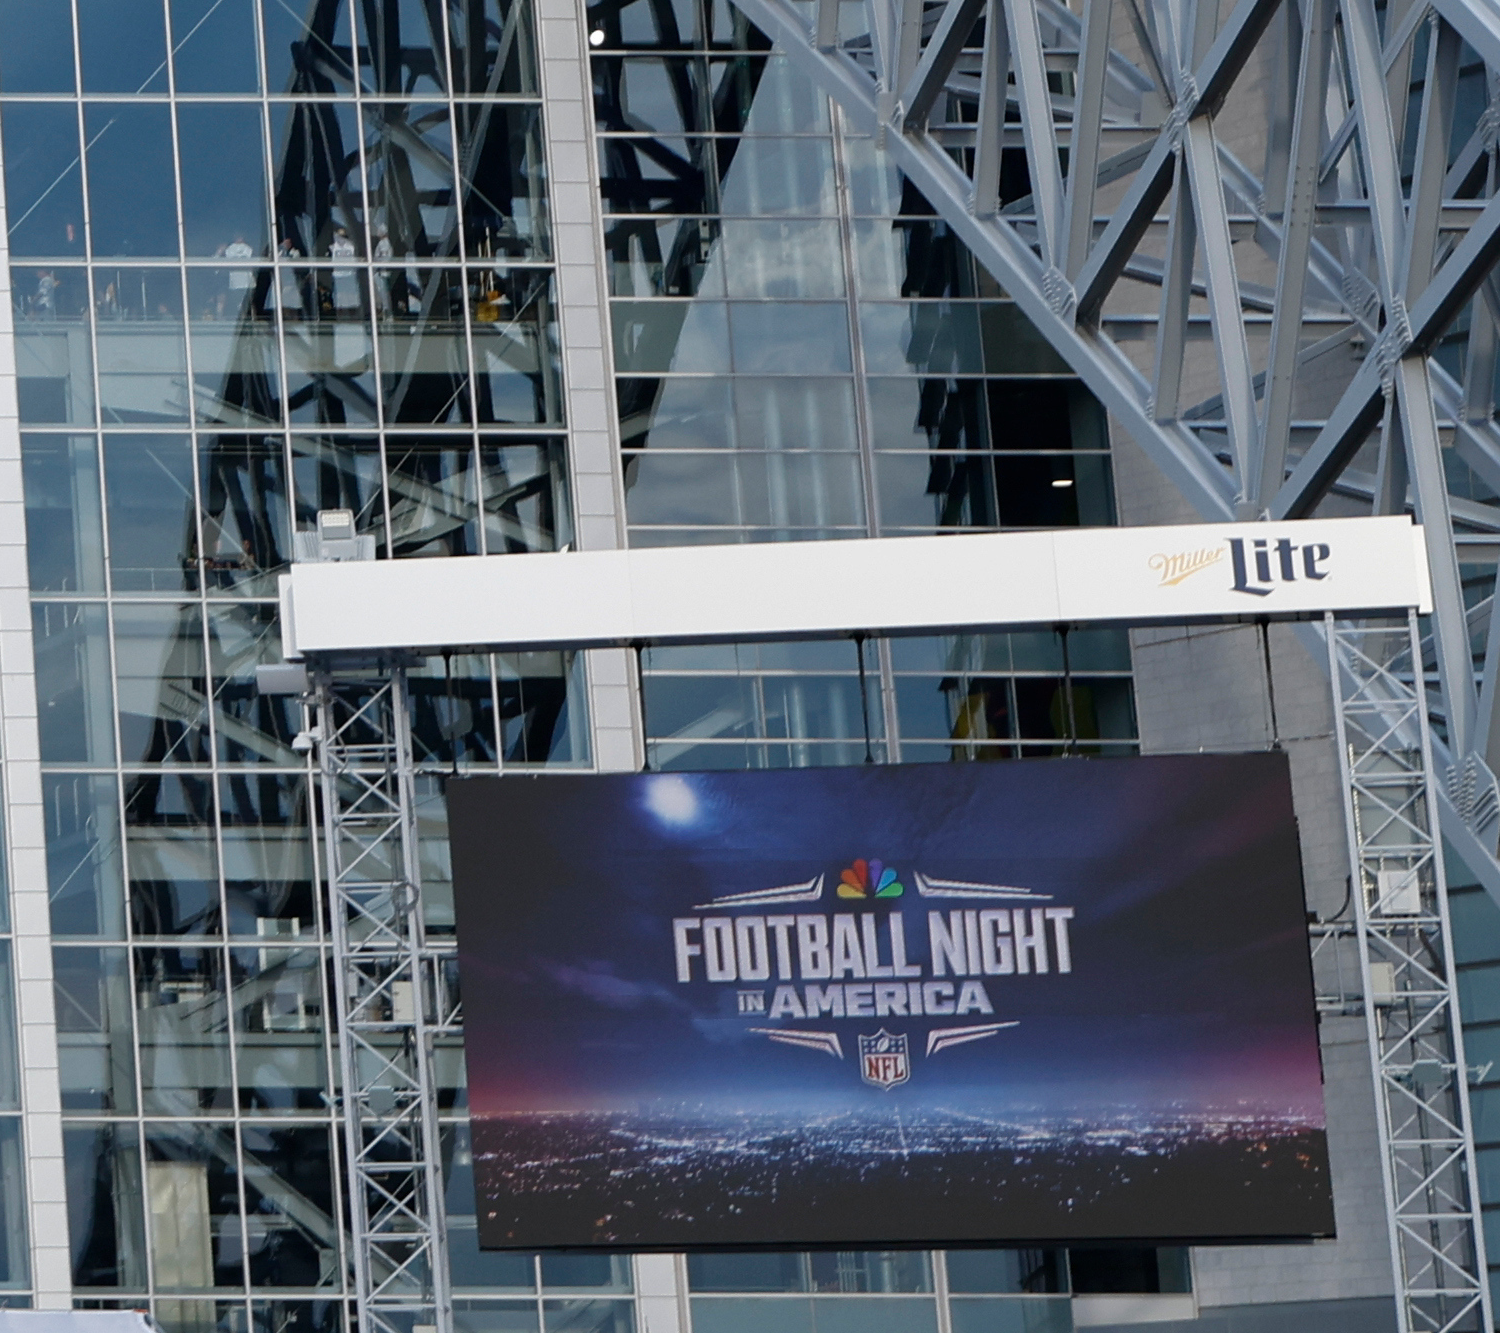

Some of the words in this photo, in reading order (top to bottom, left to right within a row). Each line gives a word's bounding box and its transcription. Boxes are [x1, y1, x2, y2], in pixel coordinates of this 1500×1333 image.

[1148, 546, 1227, 587] Miller
[1224, 537, 1331, 597] Lite
[672, 910, 922, 983] FOOTBALL
[927, 906, 1075, 977] NIGHT
[736, 989, 766, 1016] IN
[767, 980, 994, 1019] AMERICA
[866, 1056, 905, 1082] NFL
